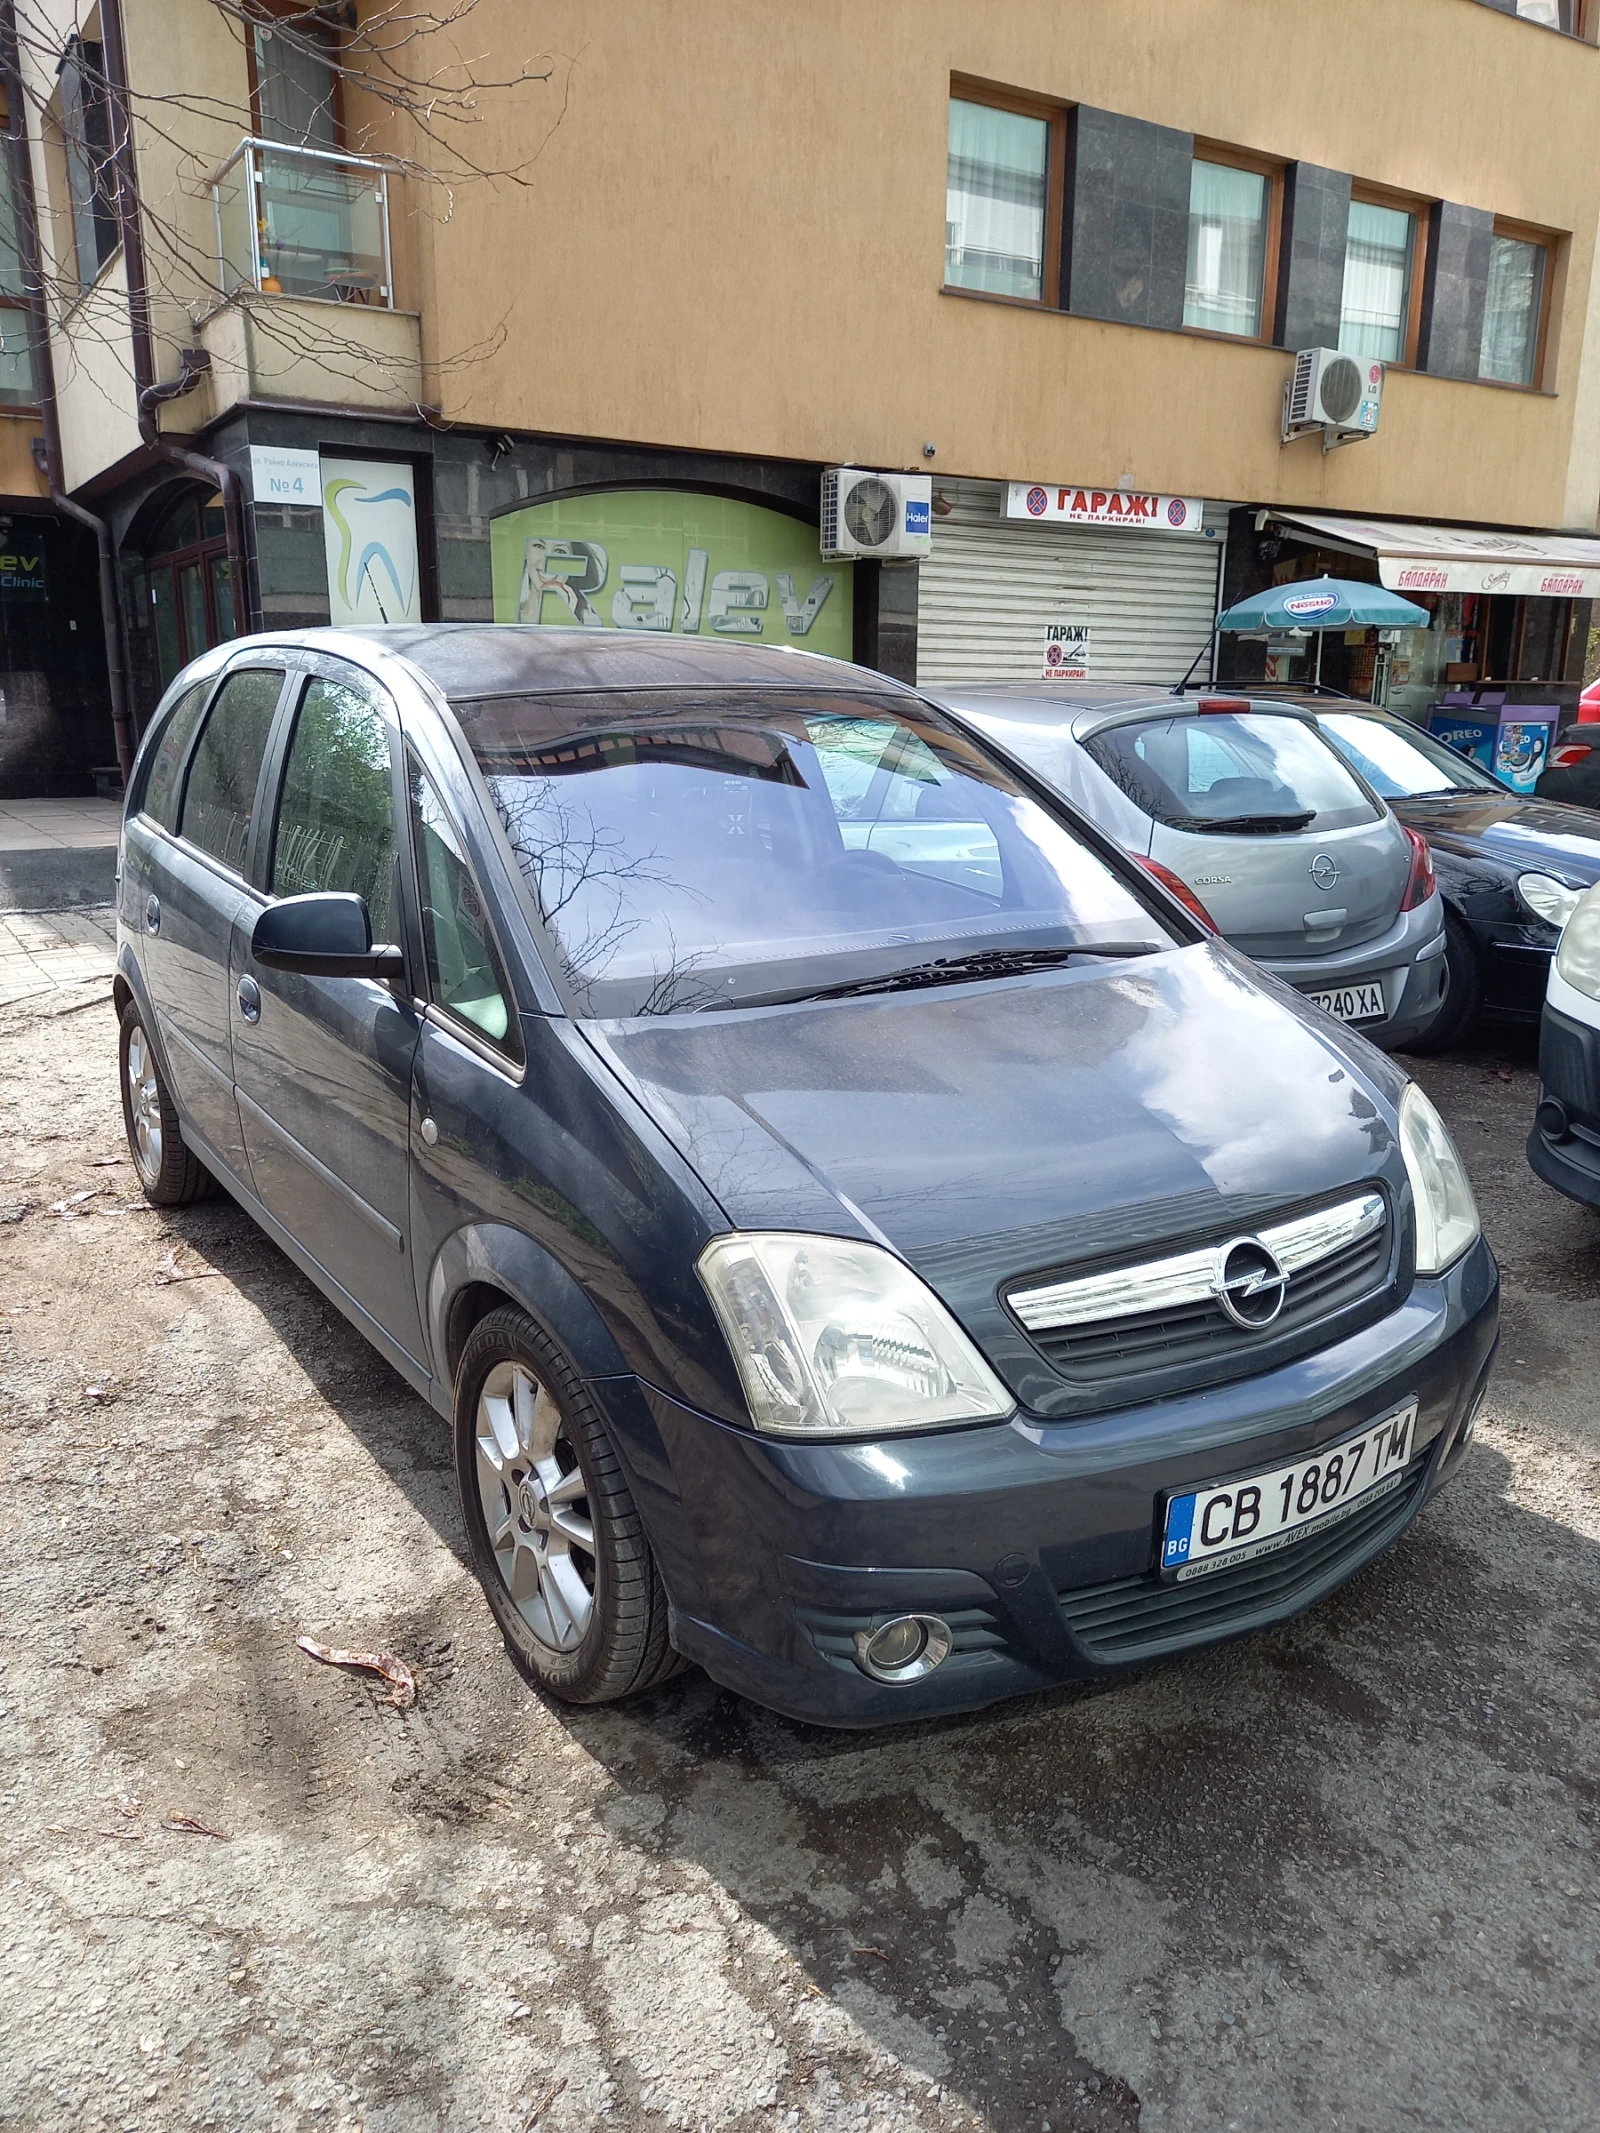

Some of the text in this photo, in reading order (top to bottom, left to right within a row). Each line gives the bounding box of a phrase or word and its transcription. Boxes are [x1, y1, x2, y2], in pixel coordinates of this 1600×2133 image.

[1368, 385, 1377, 394] LG
[1057, 489, 1159, 517] ГАРАЖ!
[906, 512, 928, 523] Haier
[1, 576, 45, 588] Clinic
[518, 537, 834, 633] Ralev
[1047, 625, 1088, 642] ГАРАЖ!
[1438, 729, 1482, 744] OREO
[1194, 875, 1232, 885] CORSA
[1356, 987, 1381, 1014] XA
[1200, 1413, 1411, 1547] CB 1887 TM
[1167, 1537, 1188, 1556] BG
[1185, 1564, 1209, 1577] 0888
[1211, 1557, 1228, 1569] 328
[1229, 1551, 1247, 1563] 005
